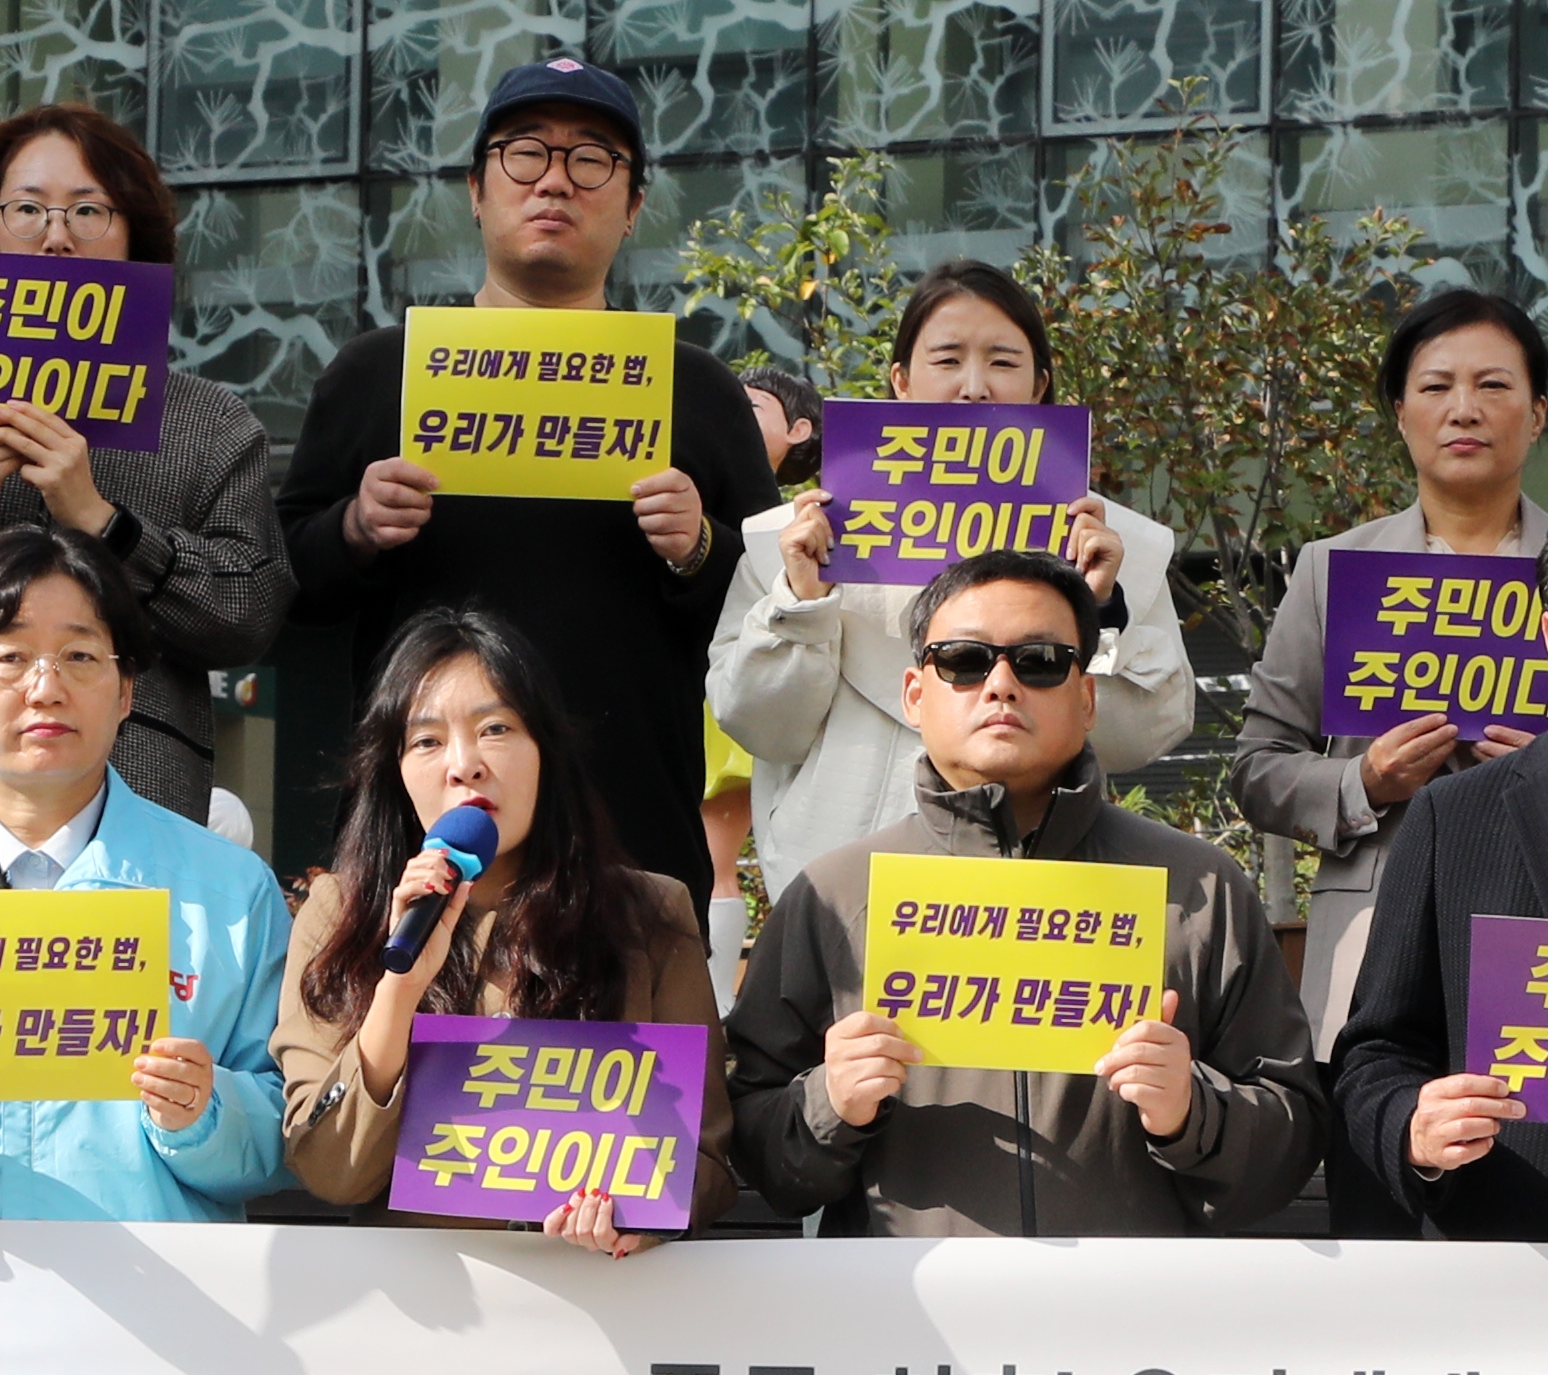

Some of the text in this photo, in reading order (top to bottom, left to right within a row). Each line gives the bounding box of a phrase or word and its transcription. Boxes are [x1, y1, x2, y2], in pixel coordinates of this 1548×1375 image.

[429, 349, 654, 387] 우리에게 필요한 법,
[416, 411, 659, 458] 우리가 만들자!
[874, 427, 1043, 484] 주민이
[842, 501, 1069, 558] 주인이다
[1378, 577, 1542, 639] 주민이
[894, 903, 1143, 948] 우리에게 필요한 법,
[18, 938, 101, 970] 필요한
[115, 940, 146, 971] 법,
[880, 972, 1149, 1027] 우리가 만들자!
[18, 1010, 156, 1055] 만들자!
[465, 1046, 655, 1114] 주민이
[421, 1125, 675, 1198] 주인이다
